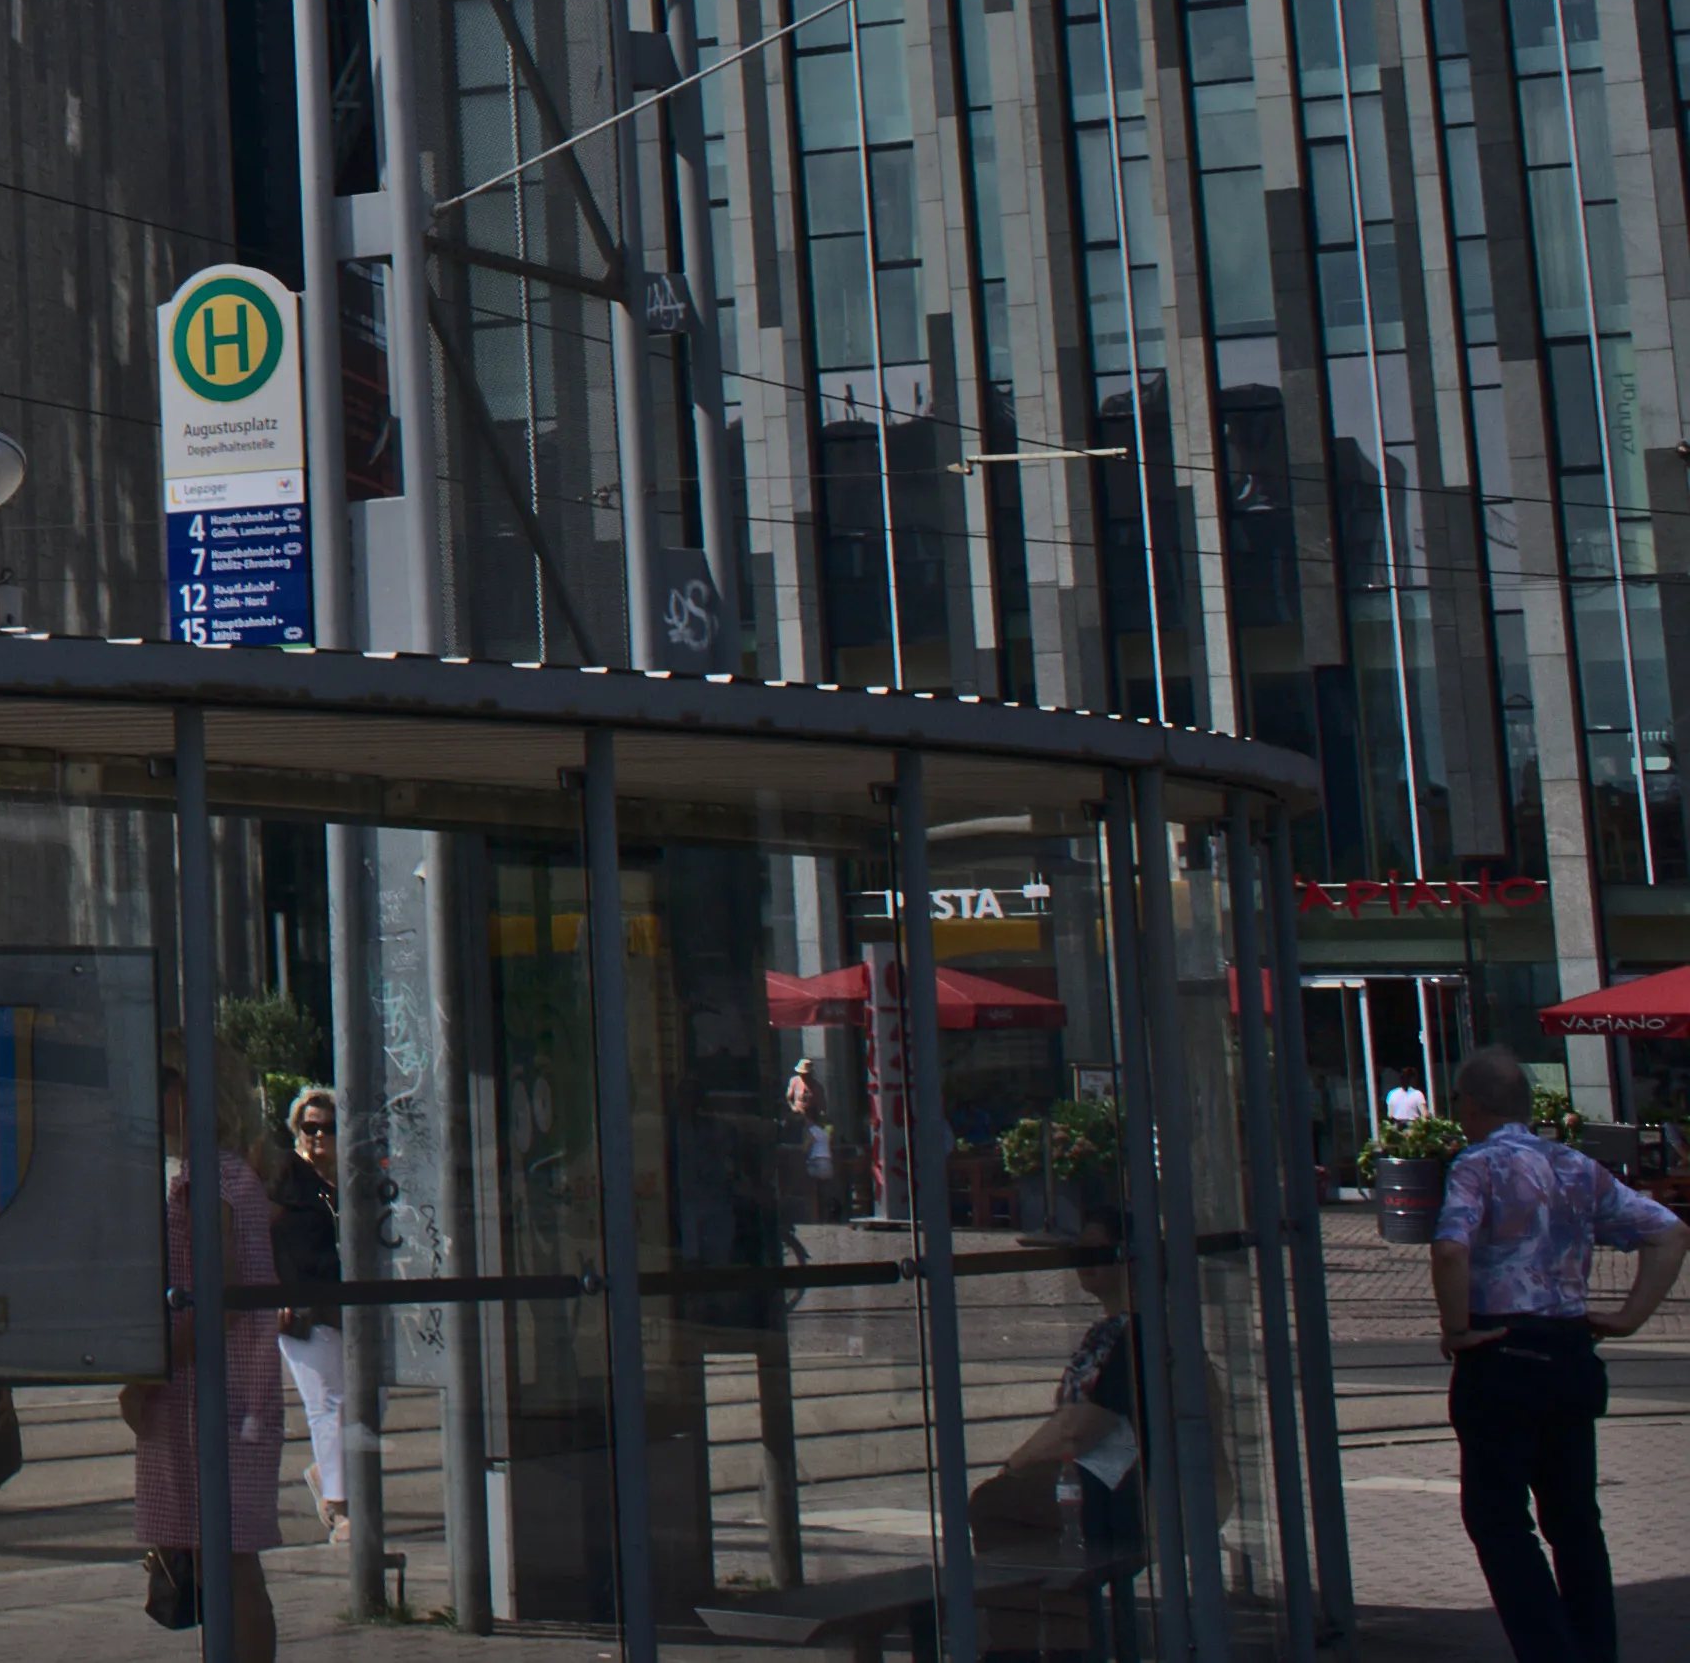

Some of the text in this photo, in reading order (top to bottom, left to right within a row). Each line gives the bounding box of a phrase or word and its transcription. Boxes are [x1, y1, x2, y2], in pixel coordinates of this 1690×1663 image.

[203, 304, 250, 376] H
[183, 417, 278, 439] Augustusplatz
[187, 438, 275, 457] Doppelhaltestelle
[188, 514, 207, 542] 4
[190, 547, 207, 576] 7
[179, 583, 208, 612] 12
[179, 618, 208, 645] 15
[884, 888, 1005, 921] PSTA
